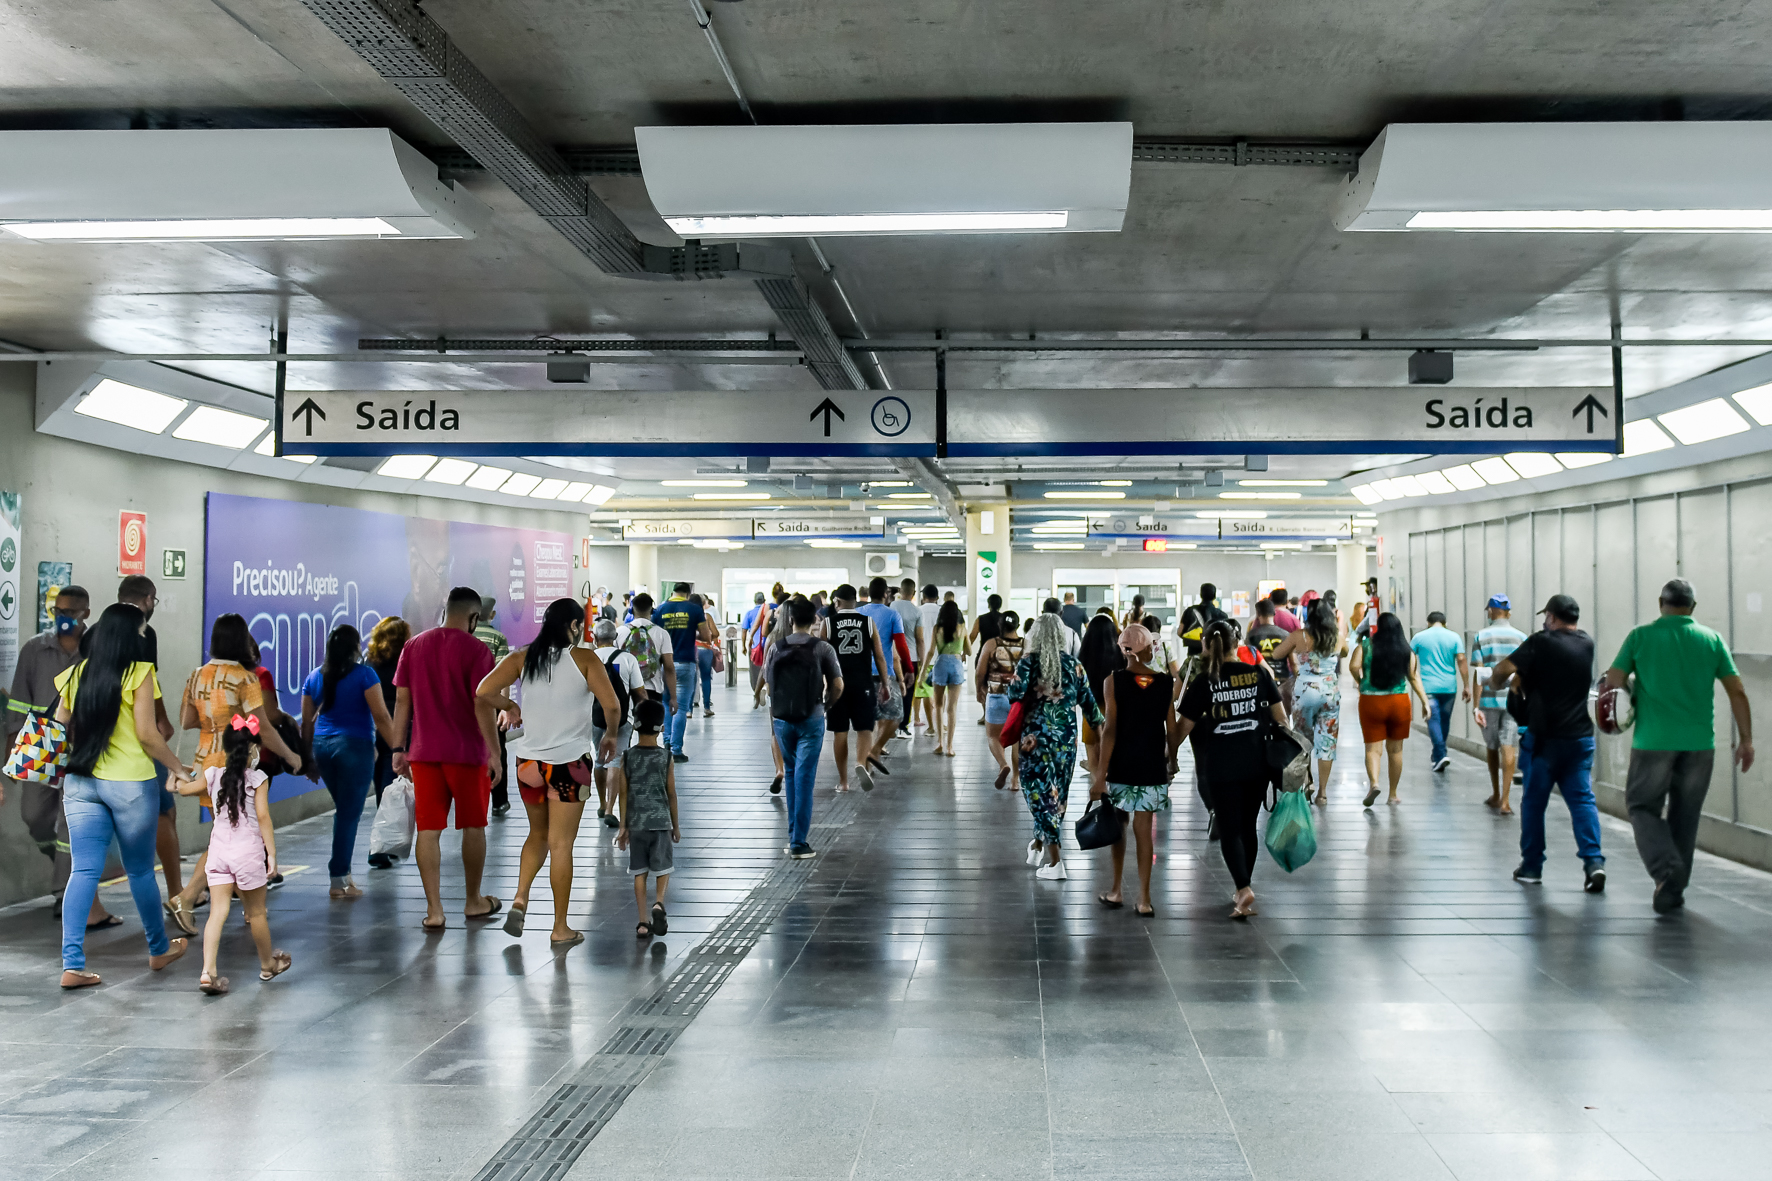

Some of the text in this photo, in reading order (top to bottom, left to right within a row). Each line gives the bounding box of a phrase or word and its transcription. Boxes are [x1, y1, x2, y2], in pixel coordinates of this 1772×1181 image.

[356, 400, 460, 430] Saída
[1425, 398, 1532, 429] Saída
[645, 524, 676, 533] Saída
[778, 521, 810, 532] Saída
[1233, 521, 1265, 532] Saída
[233, 560, 305, 597] Precisou?
[836, 618, 863, 629] JORDAN
[837, 629, 864, 655] 23
[1230, 672, 1258, 687] DEUS
[1231, 698, 1256, 716] DEUS
